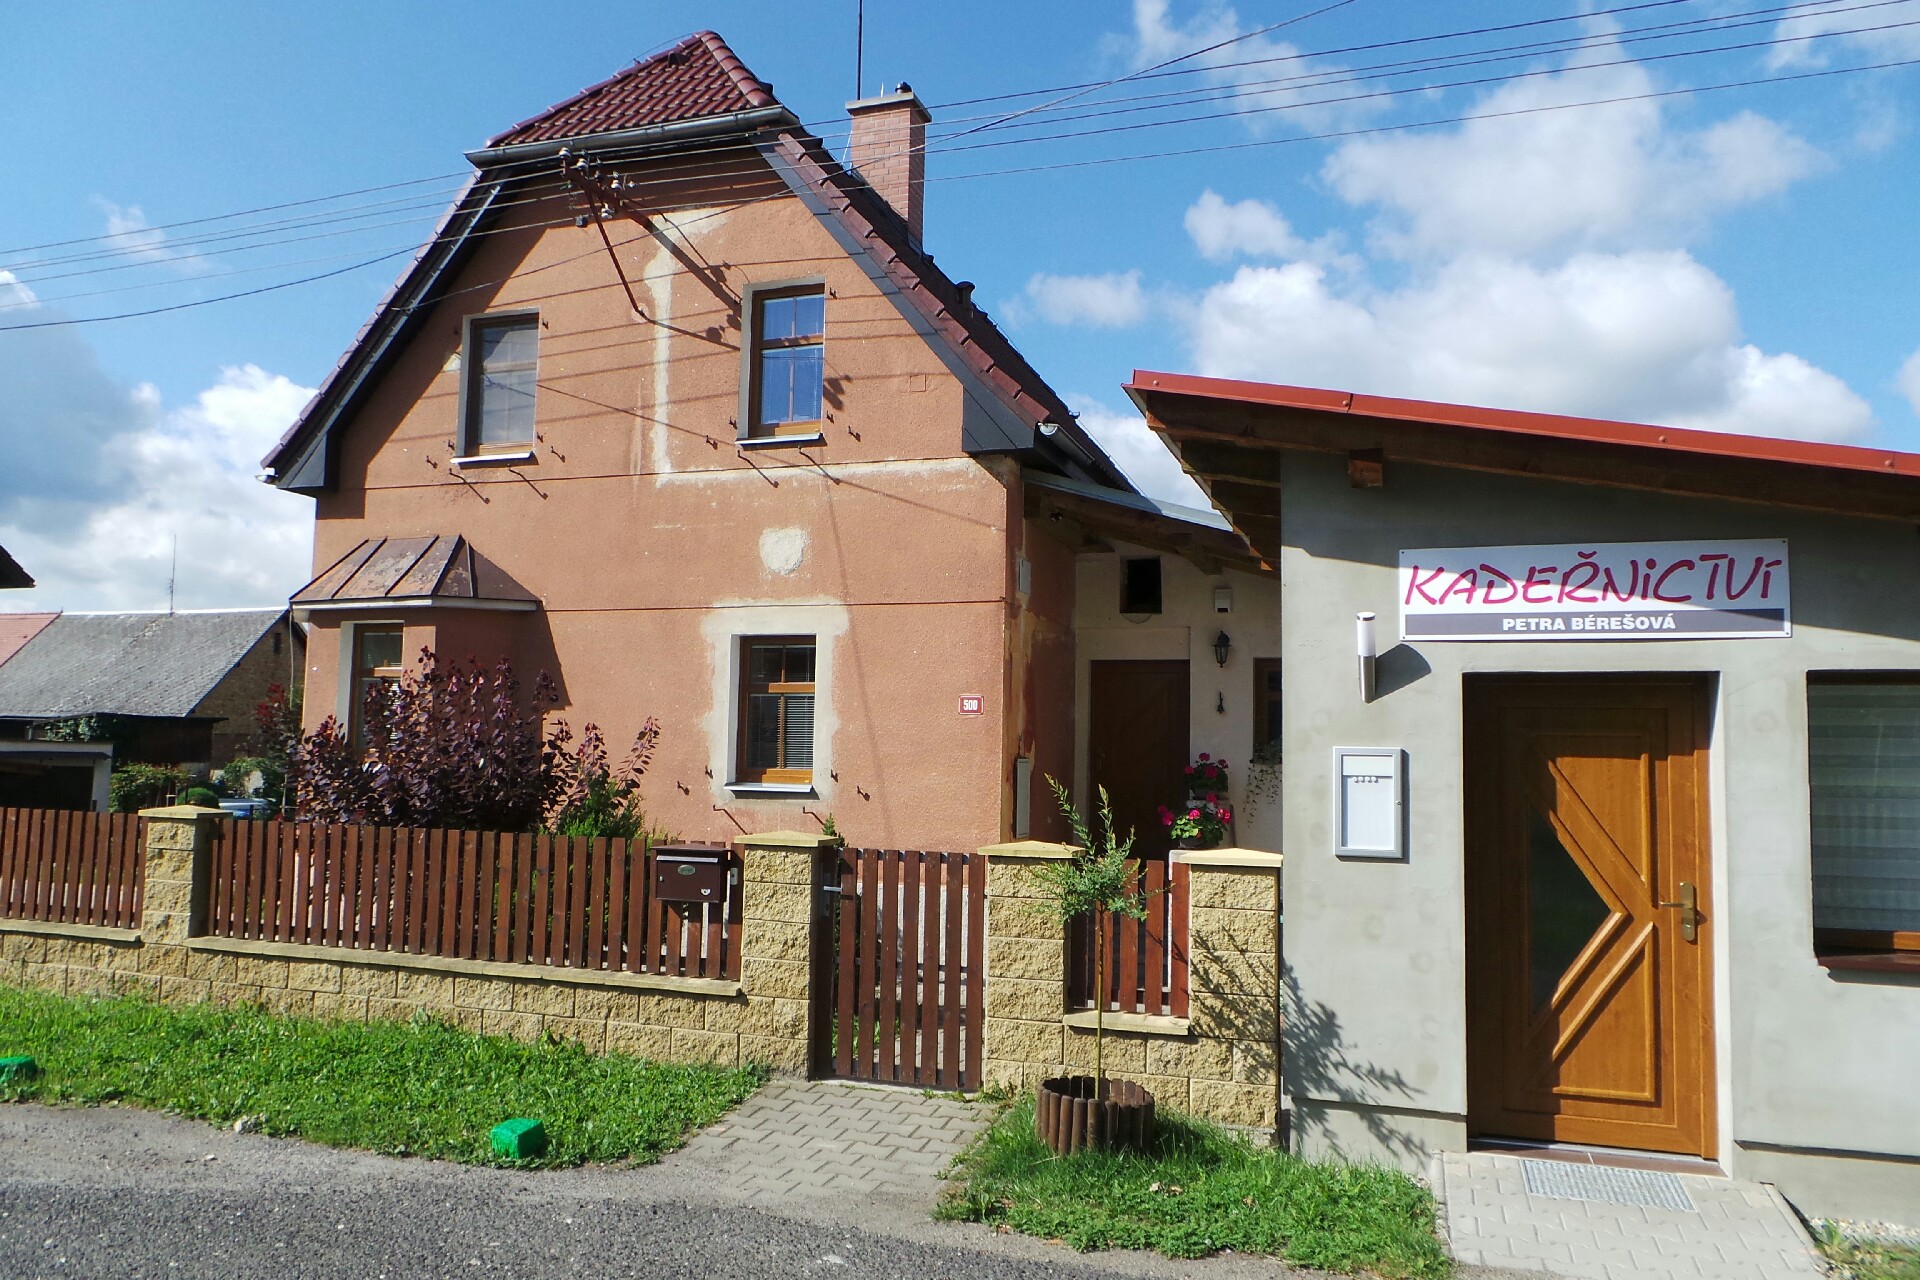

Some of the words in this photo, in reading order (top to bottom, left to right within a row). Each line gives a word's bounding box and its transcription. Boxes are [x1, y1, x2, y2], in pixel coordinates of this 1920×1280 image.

[1502, 617, 1566, 631] PETRA
[1571, 613, 1676, 631] BÉREŠOVÁ
[963, 699, 979, 711] 500
